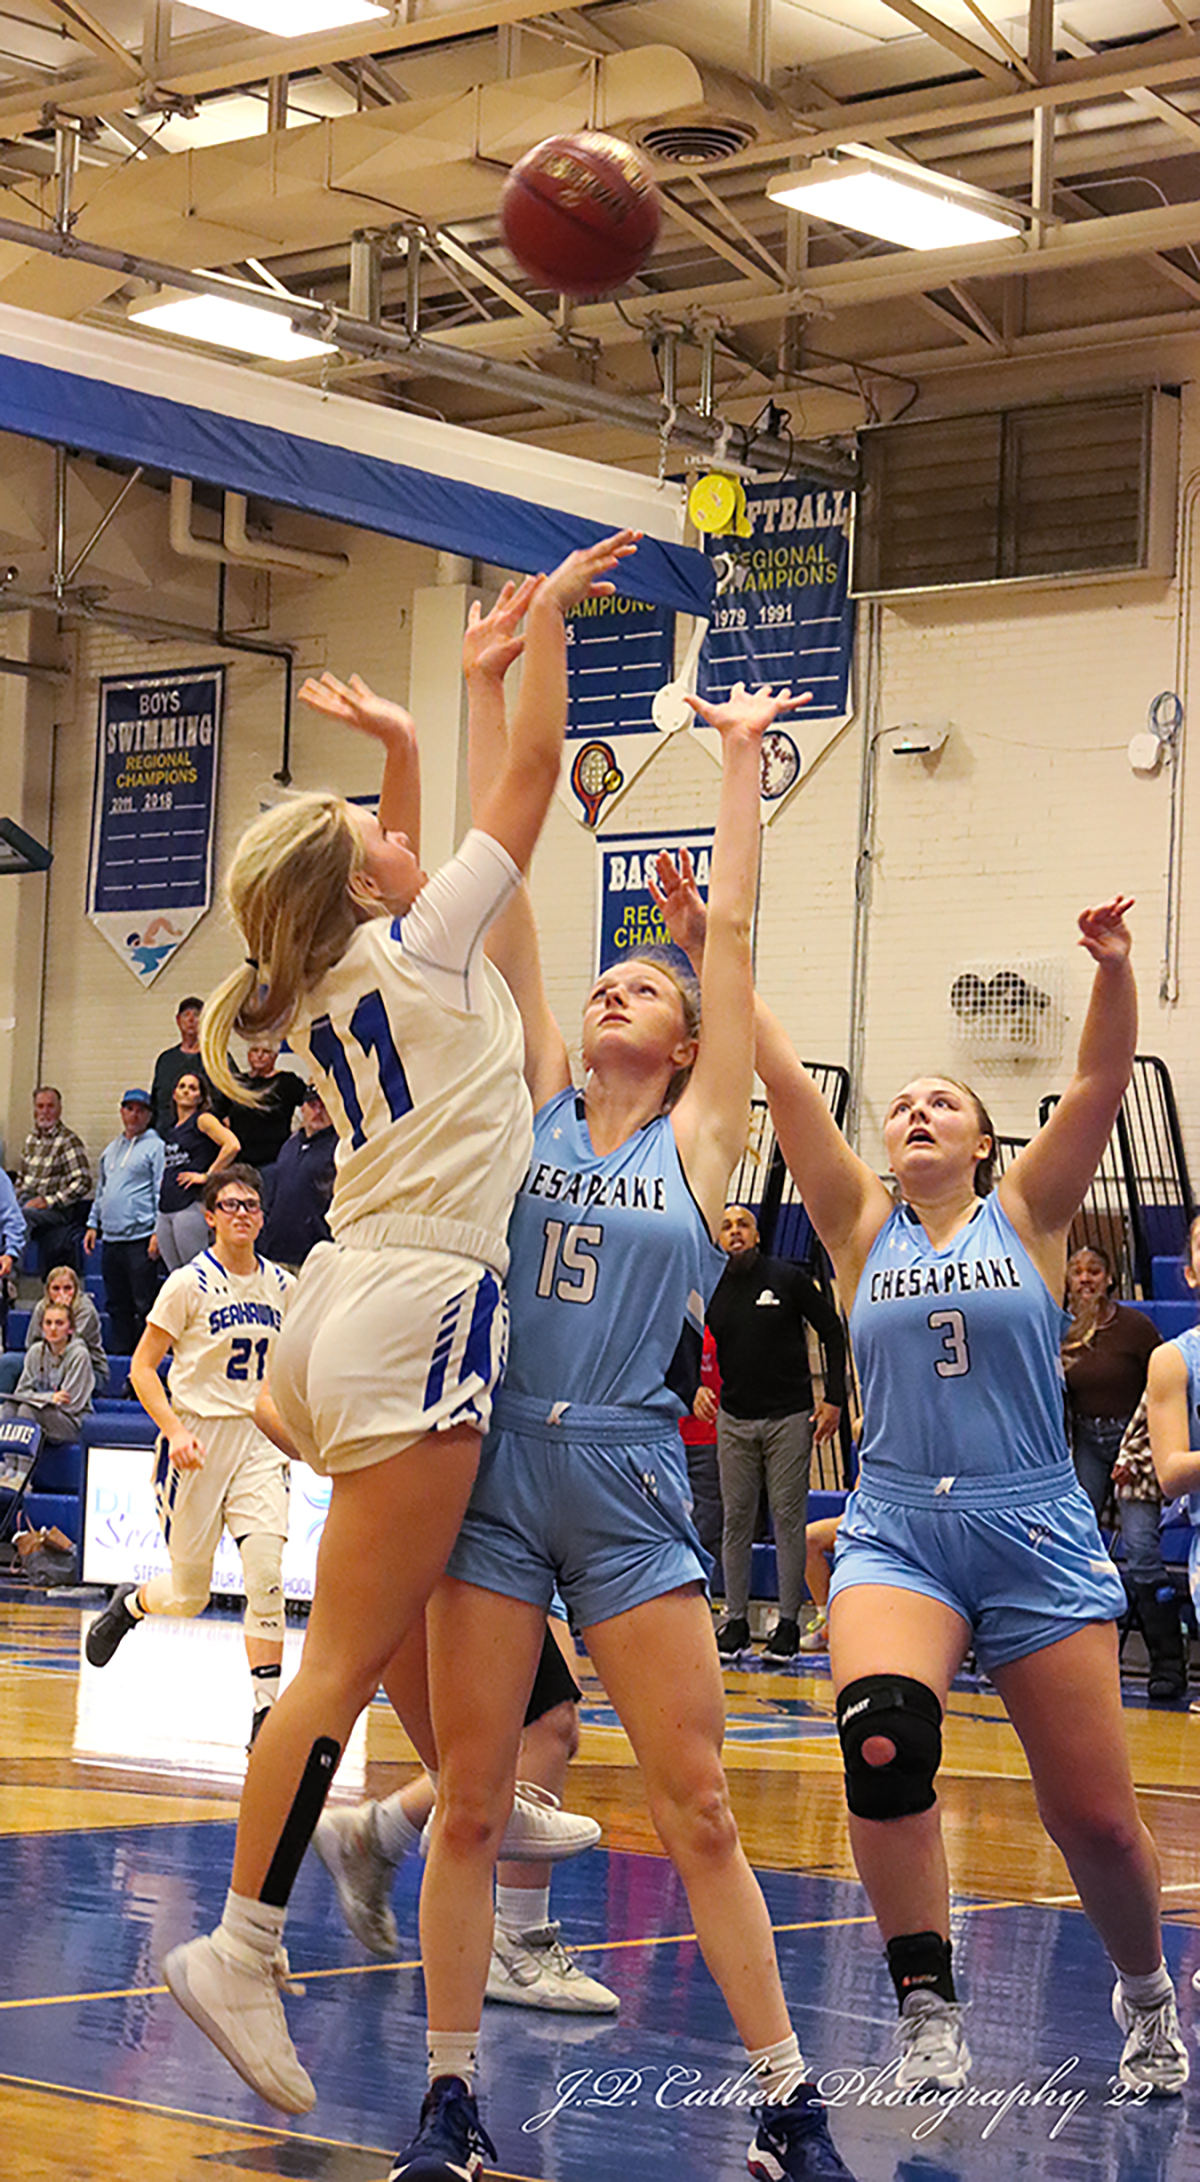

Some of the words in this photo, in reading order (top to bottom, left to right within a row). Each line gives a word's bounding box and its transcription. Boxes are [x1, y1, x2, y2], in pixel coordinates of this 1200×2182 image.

[746, 491, 848, 533] FTBALL
[744, 564, 838, 593] AMPIONS
[714, 607, 747, 628] 1979
[758, 603, 793, 624] 1991
[139, 690, 181, 716] BOYS
[106, 713, 213, 754] SWIMMING
[116, 767, 198, 789] CHAMPIONS
[125, 752, 192, 770] REGIONAL
[309, 988, 415, 1152] 11
[535, 1216, 604, 1305] 15
[870, 1256, 1021, 1303] CHESAPEAKE
[226, 1337, 270, 1381] 21
[927, 1307, 971, 1378] 3
